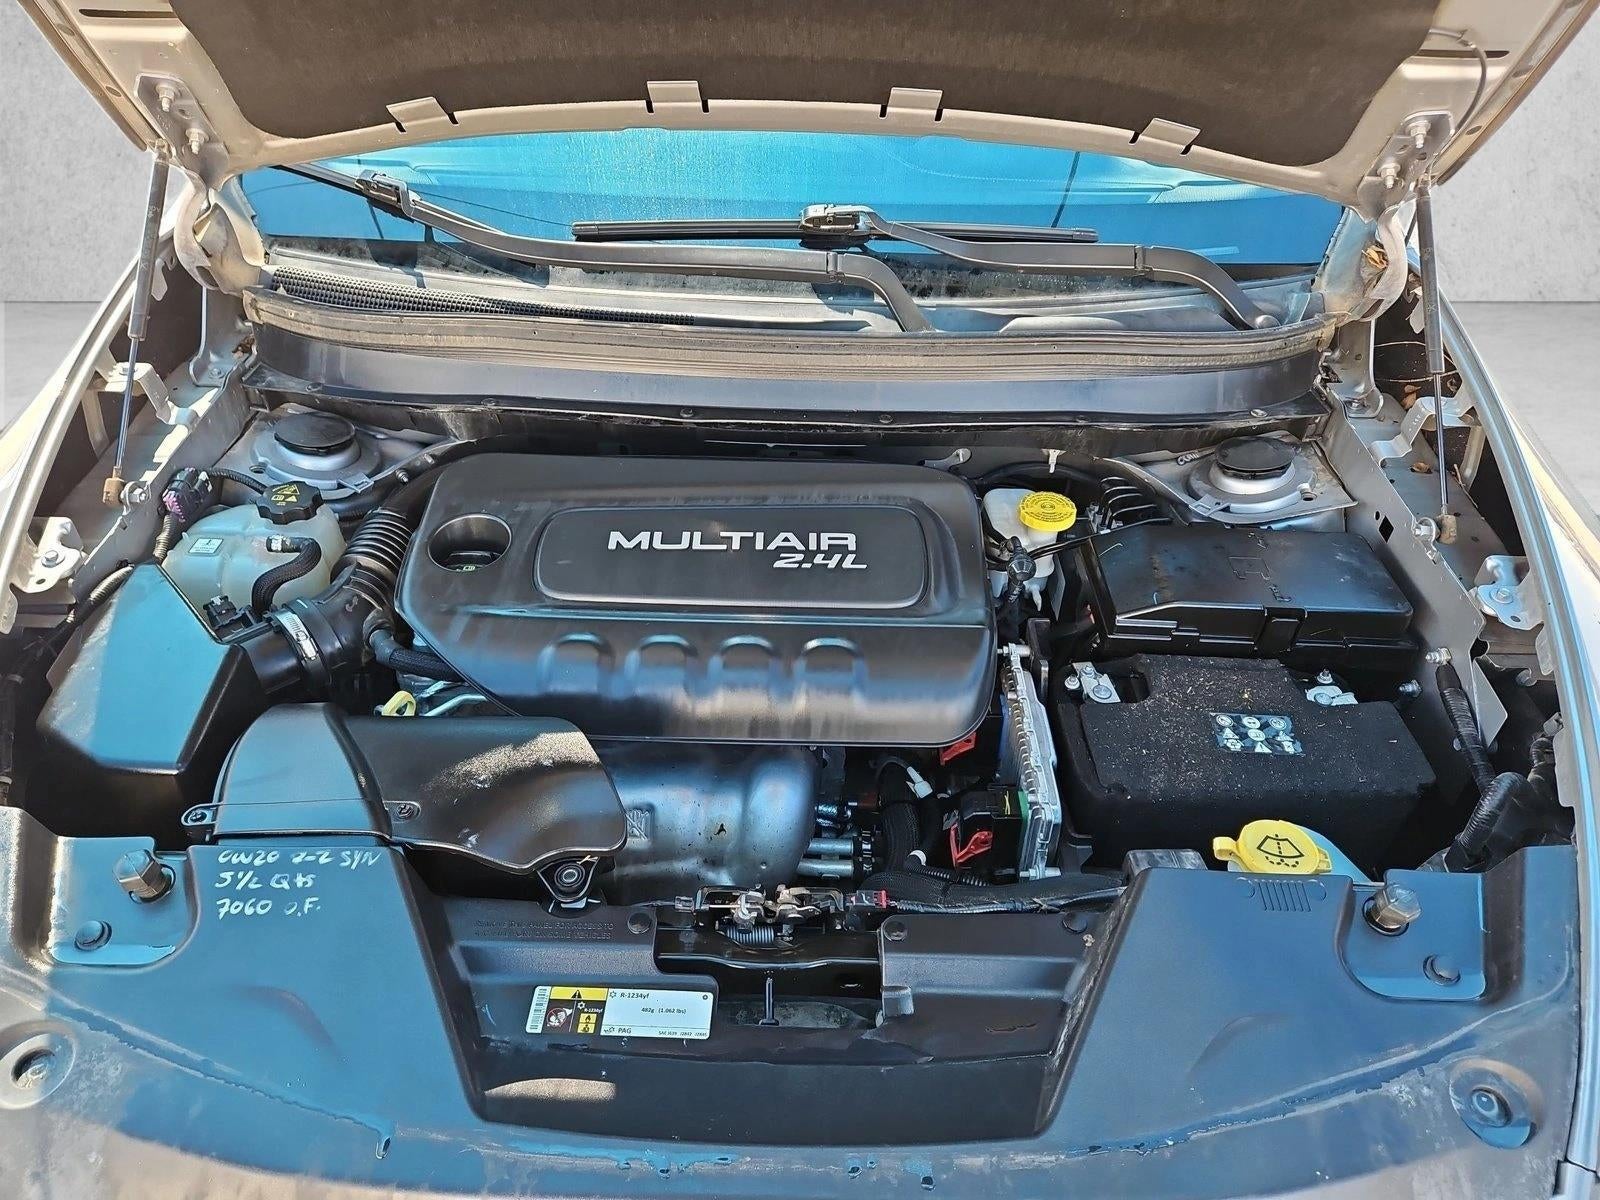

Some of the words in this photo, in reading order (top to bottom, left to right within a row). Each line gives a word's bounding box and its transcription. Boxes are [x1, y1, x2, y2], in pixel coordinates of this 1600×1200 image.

[607, 531, 858, 550] MULTIAIR
[772, 553, 868, 569] 2.4L
[216, 897, 273, 920] 7060
[620, 992, 650, 1000] R-1234yf
